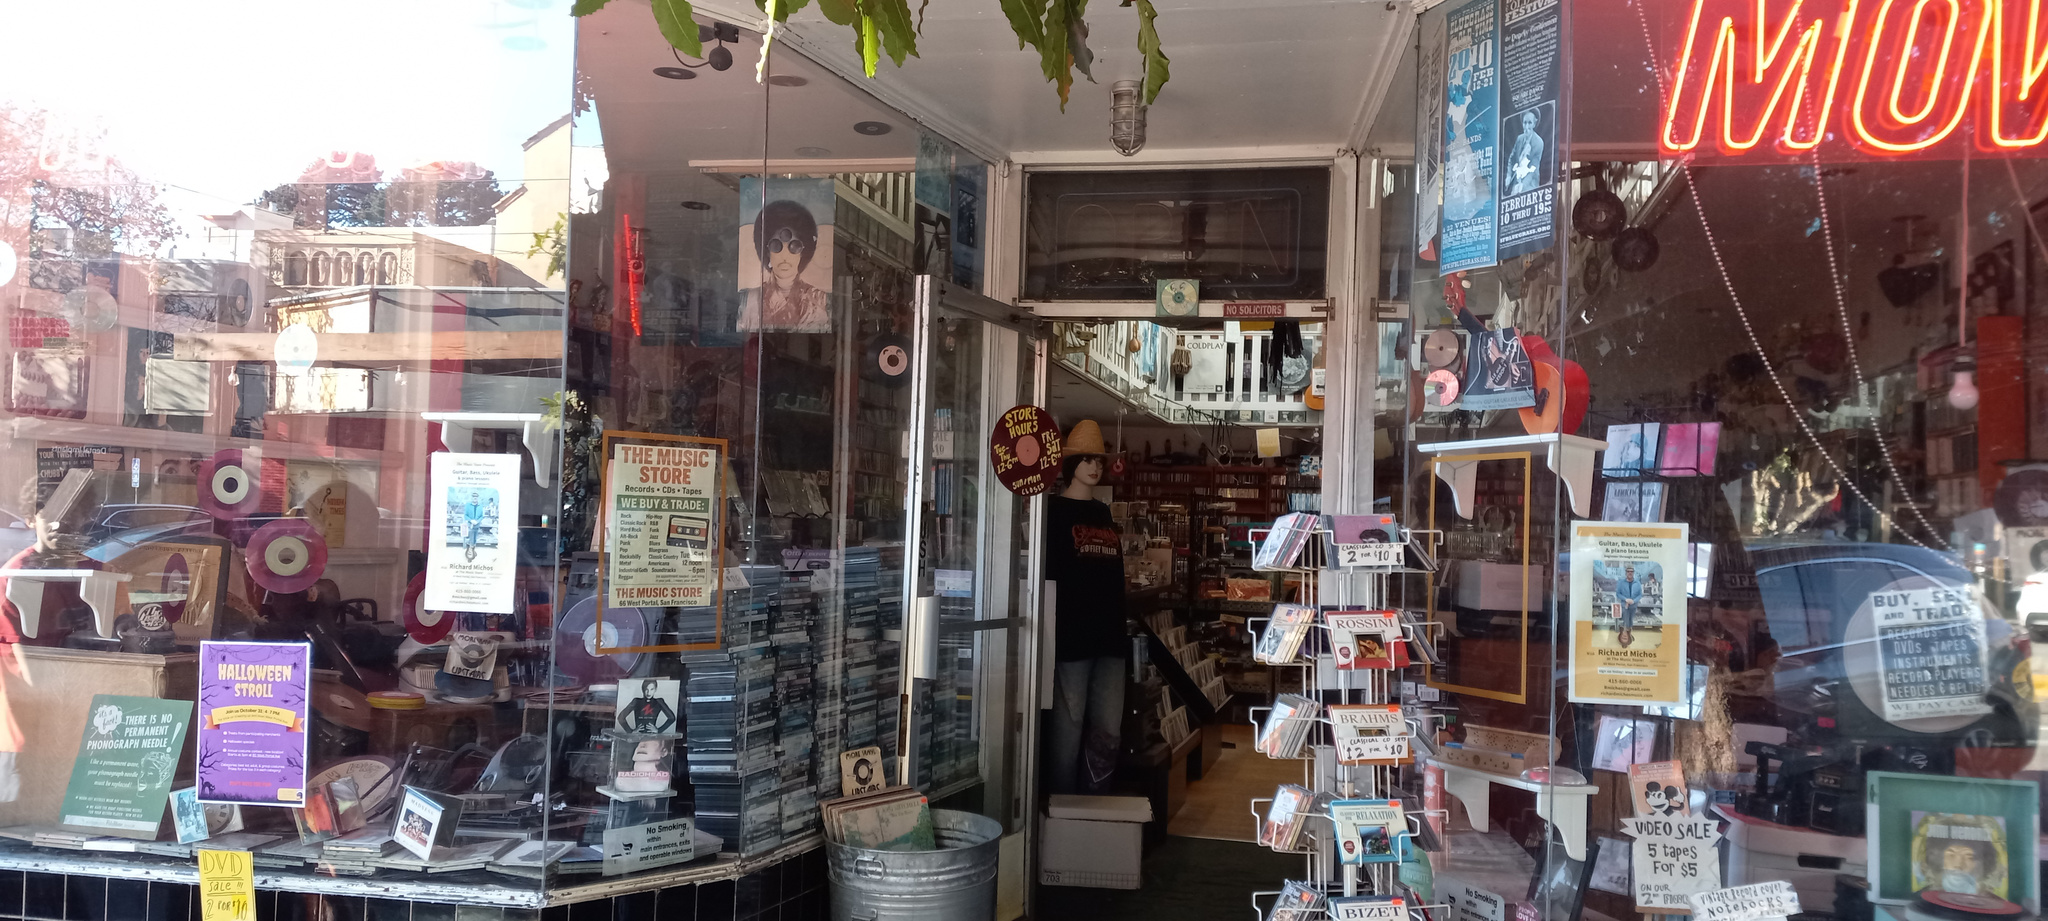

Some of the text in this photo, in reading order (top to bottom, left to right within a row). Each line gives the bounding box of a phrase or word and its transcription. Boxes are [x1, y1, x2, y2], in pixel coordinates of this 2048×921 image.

[1505, 0, 1557, 22] FESTIVA
[1473, 68, 1494, 82] FEB
[1473, 77, 1493, 91] 12-21
[1501, 190, 1544, 214] FEBRUARY
[1500, 203, 1544, 226] 10 THRU 19
[1454, 216, 1491, 229] VENUES!
[1226, 304, 1282, 316] NO SOLICITORS
[1187, 342, 1225, 350] COLDPLAY
[1005, 407, 1038, 428] STORE
[1009, 420, 1038, 439] HOURS
[621, 446, 709, 468] THE MUSIC
[639, 466, 691, 485] STORE
[625, 485, 702, 496] Records CDs Tapes
[1021, 482, 1045, 495] CLOSED
[621, 498, 705, 511] WE BUY & TRADE:
[1347, 550, 1357, 563] 2
[1374, 550, 1389, 562] $10
[616, 587, 702, 598] THE MUSIC STORE
[1884, 604, 1964, 621] AND TRAD
[1336, 618, 1394, 630] ROSSINI
[1934, 639, 1967, 651] TAPES
[1598, 649, 1657, 658] Richard Michos
[1893, 653, 1972, 669] INSTRUMENTS
[218, 663, 292, 682] HALLOWEEN
[1888, 667, 1981, 684] RECORD PLAYERS
[234, 683, 274, 698] STROLL
[1890, 682, 1981, 698] NEEDLES & BELTS
[1891, 703, 1913, 711] WE
[1918, 701, 1944, 709] PAY
[125, 713, 172, 726] THERE IS NO
[1340, 713, 1399, 724] BRAHMS
[124, 725, 169, 737] PERMANENT
[86, 739, 139, 750] PHONOGRAPH
[1350, 737, 1379, 745] CLASSICAL
[1355, 747, 1365, 759] 2
[1384, 743, 1403, 756] $10
[1355, 810, 1398, 820] RELAXATION
[646, 822, 687, 835] No Smoking
[1675, 823, 1711, 840] SALE
[653, 841, 678, 851] entrances,
[1647, 843, 1697, 861] 5 tapes
[649, 852, 671, 862] operable
[671, 848, 692, 856] windows
[203, 851, 242, 877] DVD
[1680, 862, 1698, 878] $5
[1640, 884, 1671, 892] ON OUR
[1465, 887, 1497, 908] No Smoking
[1344, 906, 1402, 919] BIZET
[1518, 906, 1535, 917] PEOPLE
